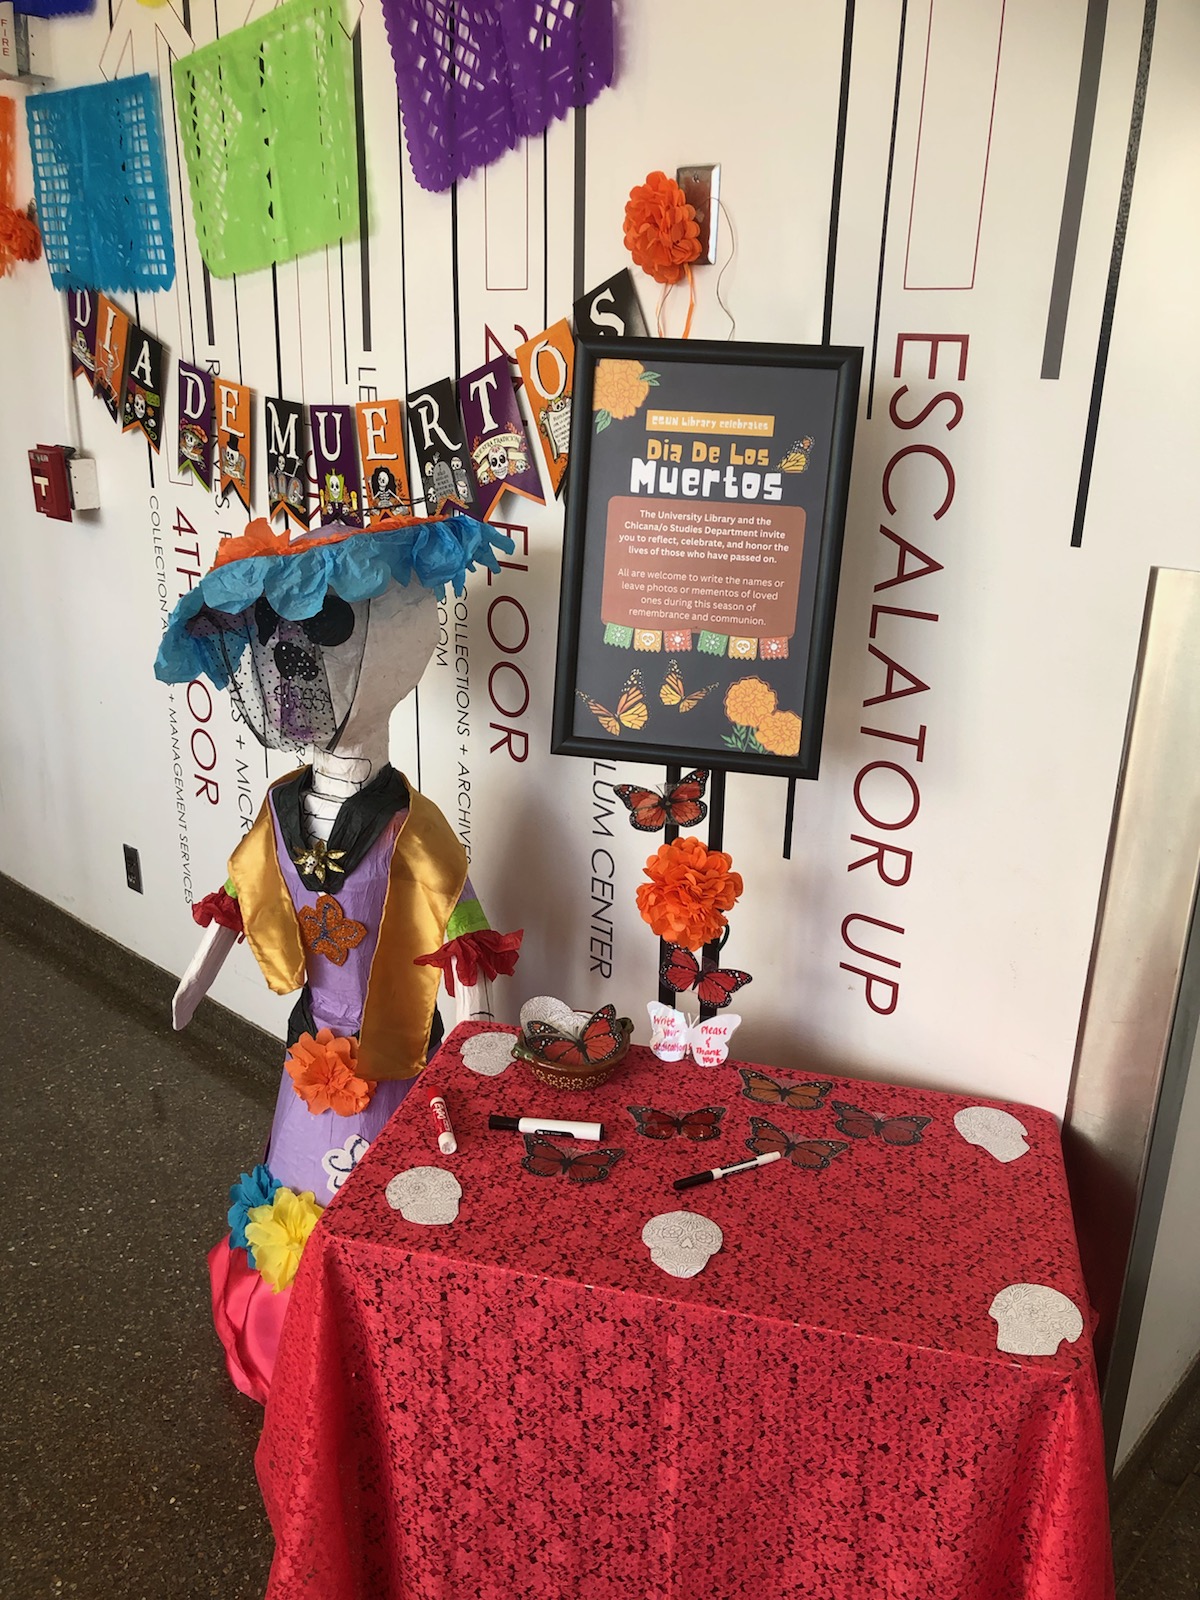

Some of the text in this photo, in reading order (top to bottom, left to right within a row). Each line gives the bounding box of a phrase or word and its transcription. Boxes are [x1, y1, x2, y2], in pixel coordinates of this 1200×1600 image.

[1, 19, 10, 56] FIRE
[179, 367, 246, 438] DE
[681, 416, 717, 429] Library
[719, 418, 769, 431] celebrates
[647, 438, 769, 466] Dia De Los
[630, 457, 783, 500] Muertos
[639, 509, 772, 526] The University Library and the
[624, 520, 786, 539] Chicana/o Studies Department invite
[619, 534, 789, 552] you to reflect, celebrate, and honor the
[149, 494, 169, 613] COLLECTION
[628, 545, 648, 555] lives
[649, 547, 660, 555] of
[660, 547, 685, 557] those
[686, 549, 705, 559] who
[706, 550, 729, 560] have
[729, 554, 761, 565] passed
[617, 567, 629, 576] All
[630, 570, 645, 578] are
[647, 570, 687, 581] welcome
[688, 573, 698, 582] to
[700, 574, 723, 584] write
[725, 575, 741, 585] the
[742, 578, 772, 587] names
[621, 580, 778, 600] leave photos or mementos of loved
[640, 596, 757, 612] ones during this season of
[628, 608, 766, 625] remembrance and communion.
[486, 519, 530, 763] FLOOR
[839, 333, 970, 1016] ESCALATOR UP
[187, 679, 220, 806] OOR
[168, 707, 188, 831] MANAGEMENT
[178, 833, 195, 906] SERVICES
[589, 848, 615, 979] CENTER
[653, 1015, 676, 1028] Write
[701, 1025, 728, 1036] Please
